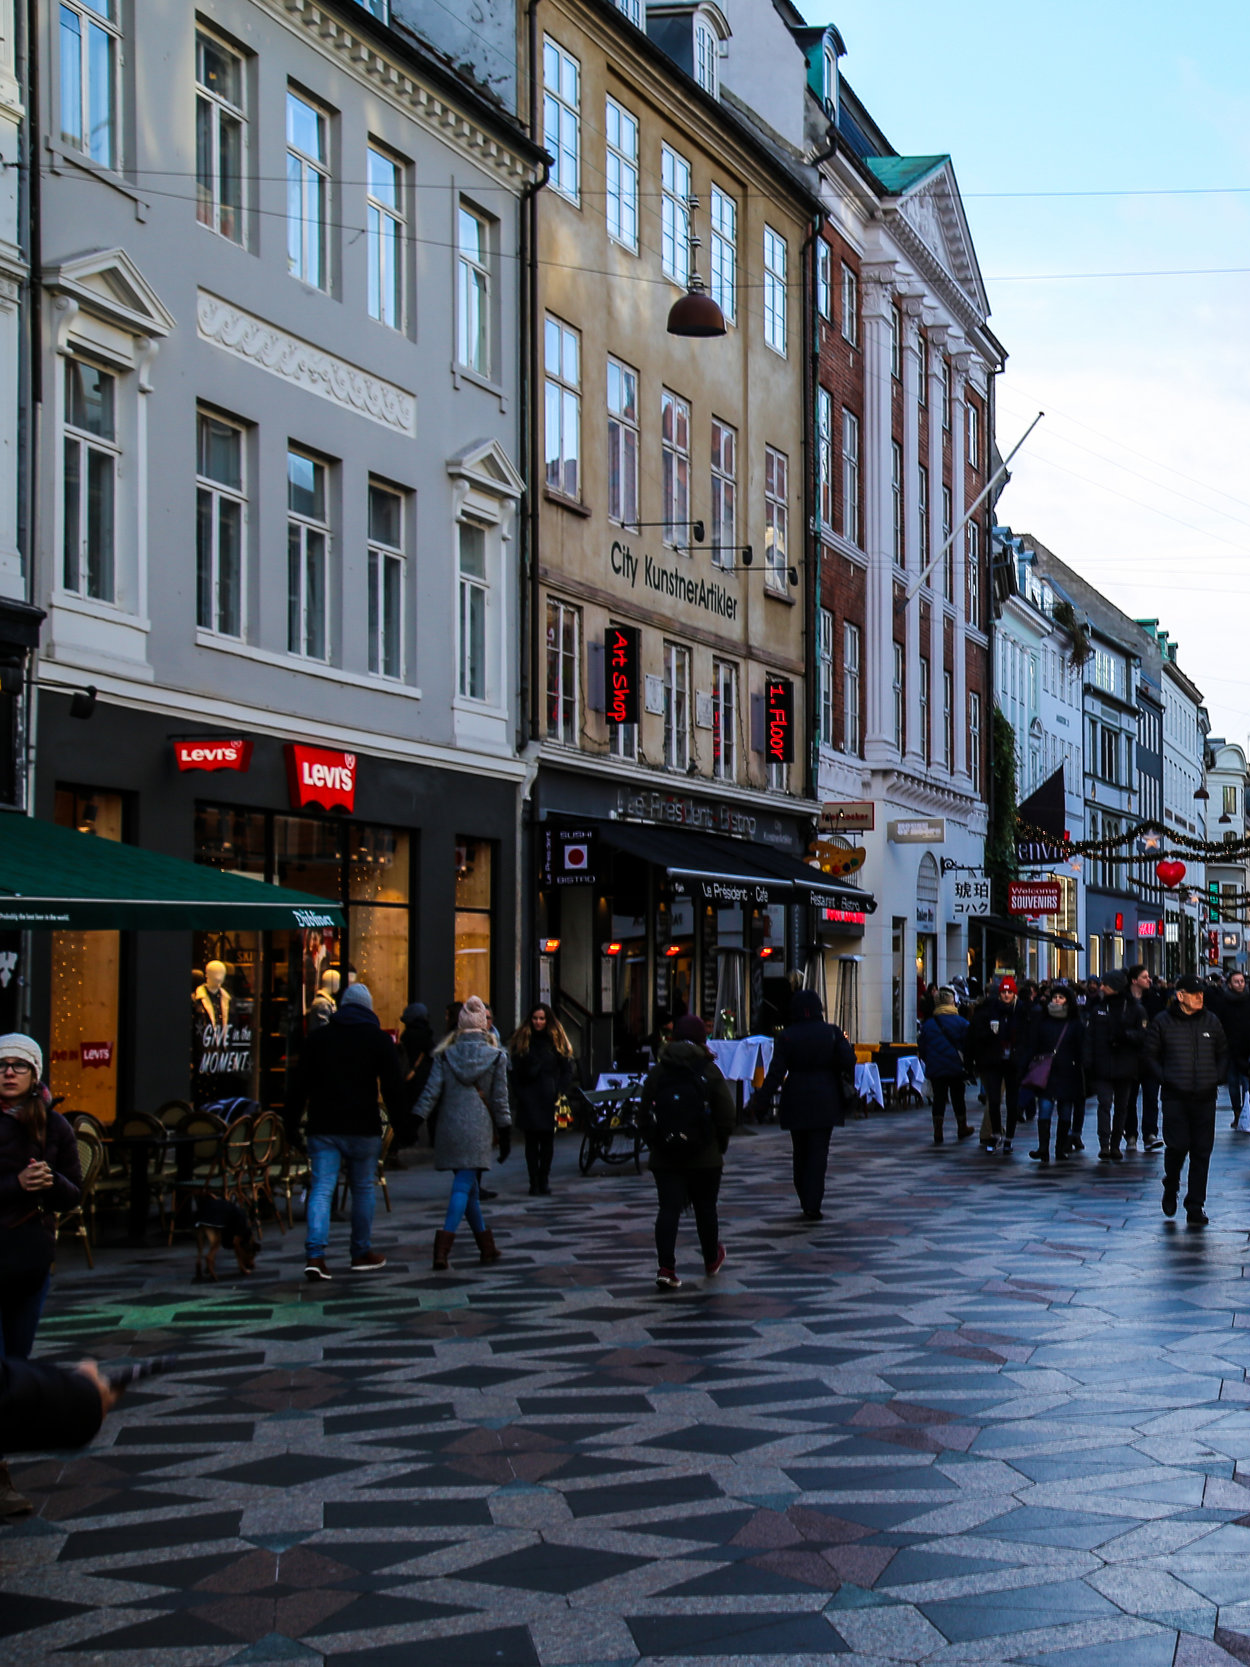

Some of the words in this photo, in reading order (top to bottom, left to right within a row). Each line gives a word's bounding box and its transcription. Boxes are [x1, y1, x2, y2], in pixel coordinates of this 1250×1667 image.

[611, 540, 638, 588] City
[645, 554, 738, 620] KunstnerArtikler
[612, 631, 629, 667] Art
[769, 708, 788, 760] Floor
[955, 881, 989, 899] 琥珀
[1011, 887, 1058, 895] Welcome
[954, 902, 989, 914] コハク
[1011, 895, 1058, 909] SOUVENIRS
[199, 1051, 250, 1073] MOMENT
